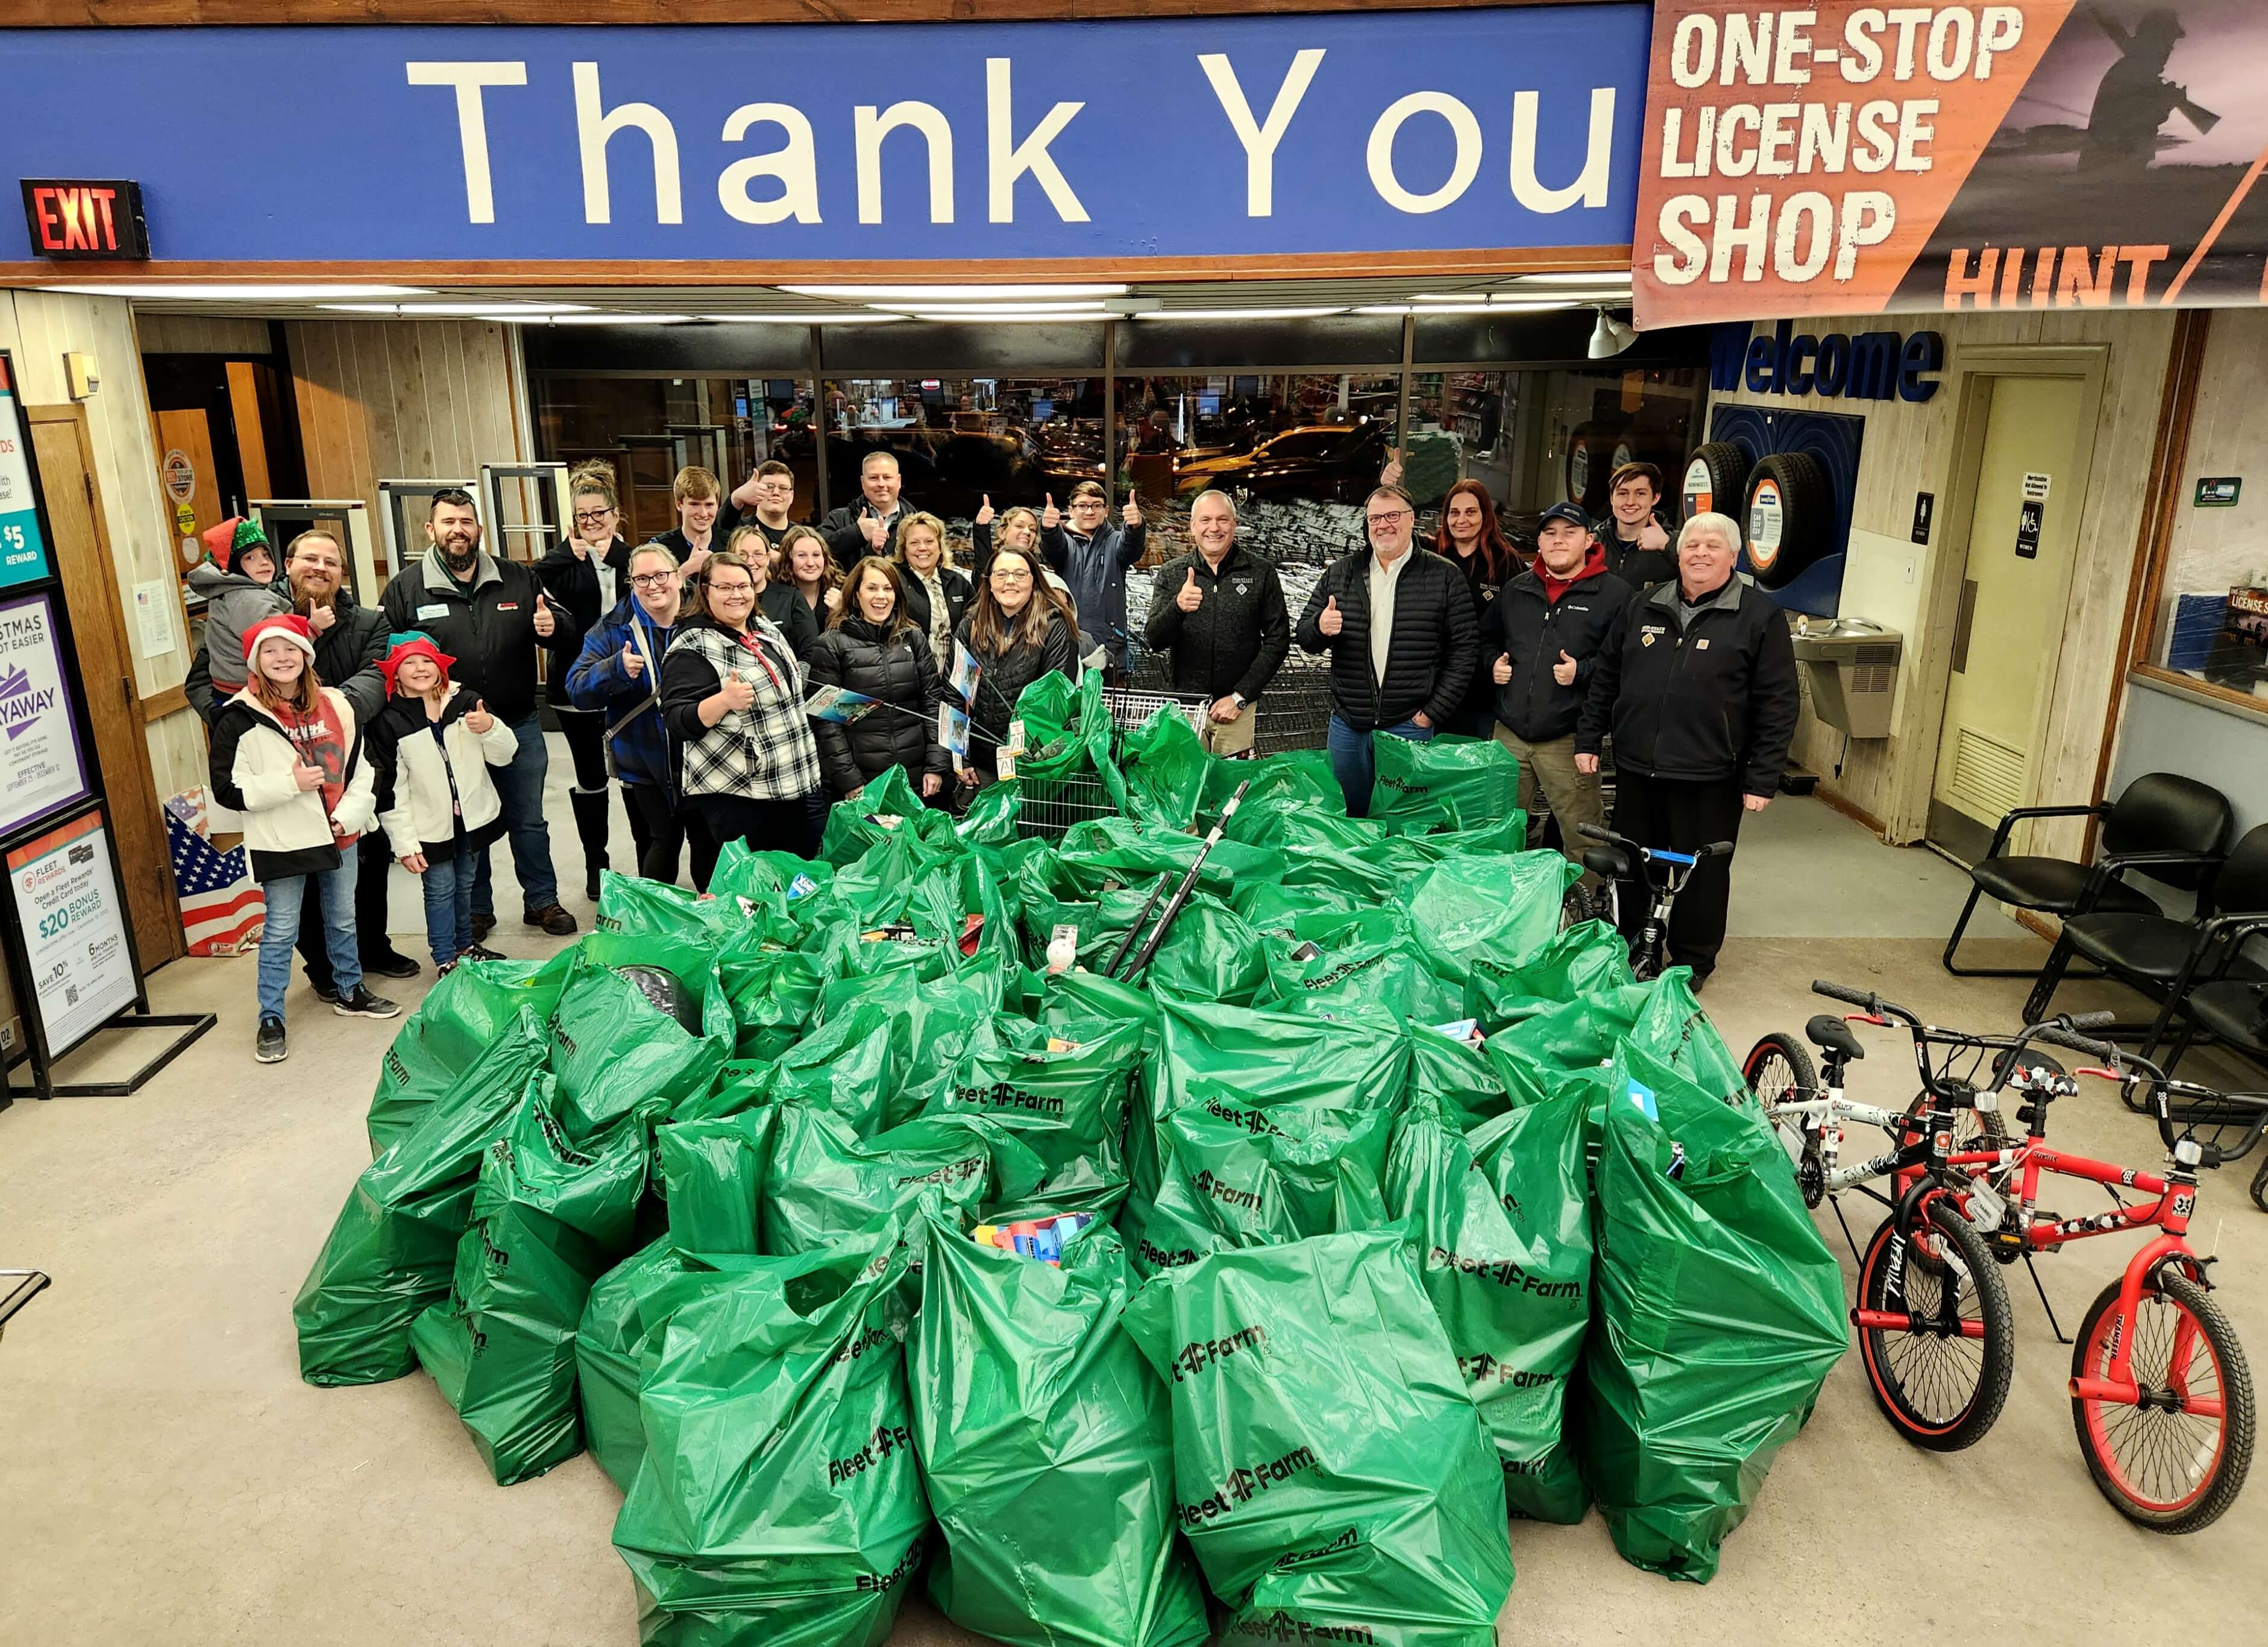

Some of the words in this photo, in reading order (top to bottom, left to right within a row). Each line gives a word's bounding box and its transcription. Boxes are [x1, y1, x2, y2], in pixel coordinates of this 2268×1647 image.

[1670, 5, 2023, 89] ONE-STOP
[407, 58, 1091, 224] Thank
[1197, 50, 1616, 218] You
[1659, 99, 1939, 177] LICENSE
[34, 189, 116, 250] EXIT
[1653, 192, 1896, 285] SHOP
[1944, 244, 2168, 308] HUNT
[1710, 316, 1946, 402] Welcome
[0, 475, 11, 486] ith
[4, 525, 25, 550] $5
[6, 551, 37, 565] REWARD
[2232, 594, 2264, 614] LICENSE
[12, 633, 45, 650] EASIER
[0, 687, 54, 725] YAWAY
[17, 762, 45, 778] EFFECTIVE
[1379, 774, 1396, 789] Fleet
[36, 860, 57, 878] FLEET
[34, 892, 50, 904] Open
[55, 880, 69, 892] Fleet
[42, 896, 60, 909] Credit
[60, 889, 74, 899] Card
[74, 881, 89, 893] today
[69, 889, 99, 913] BONUS
[39, 908, 68, 939] $20
[89, 943, 95, 956] 6
[95, 934, 119, 952] MONTHS
[38, 974, 54, 989] SAVE
[52, 960, 68, 979] 10%
[1303, 972, 1339, 990] Fleet
[386, 1051, 410, 1086] Farm
[1014, 1089, 1064, 1112] Farm
[1836, 1101, 1855, 1111] Razor
[1211, 1180, 1263, 1211] Farm
[1137, 1238, 1176, 1268] Fleet
[1430, 1246, 1488, 1277] Fleet
[1521, 1275, 1582, 1298] Farm
[1206, 1325, 1266, 1364] Farm
[2111, 1314, 2124, 1360] TRANSFER
[1500, 1364, 1554, 1388] Farm
[828, 1444, 878, 1487] Fleet
[1253, 1445, 1316, 1489] Farm
[1501, 1456, 1543, 1476] arm
[855, 1557, 906, 1592] Fleet
[1297, 1620, 1371, 1646] Farm
